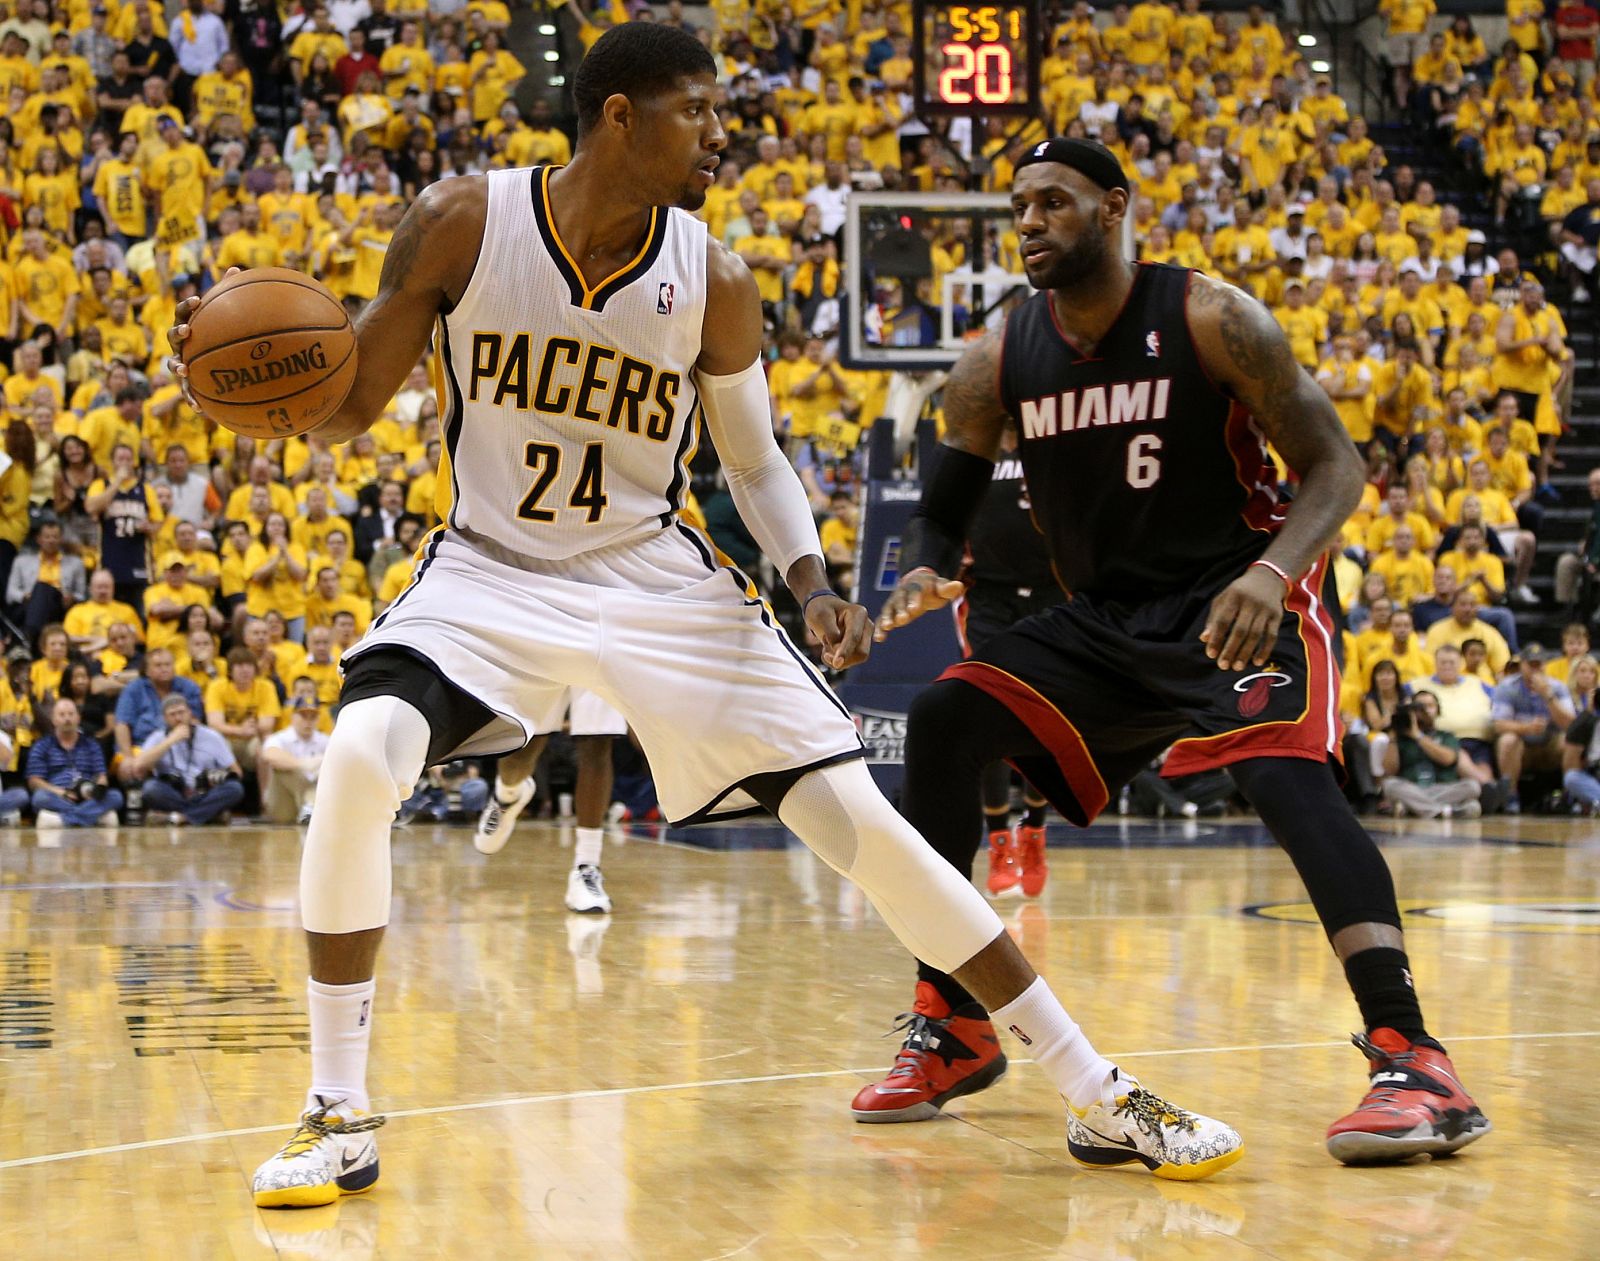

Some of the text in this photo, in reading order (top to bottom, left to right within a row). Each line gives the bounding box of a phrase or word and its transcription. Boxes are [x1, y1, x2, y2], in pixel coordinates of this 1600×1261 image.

[949, 6, 1020, 41] 5:51
[938, 44, 1011, 104] 20
[210, 341, 328, 395] SPALDING
[470, 331, 682, 442] PACERS
[1020, 378, 1171, 440] MIAMI
[516, 439, 609, 524] 24
[1125, 433, 1163, 490] 6
